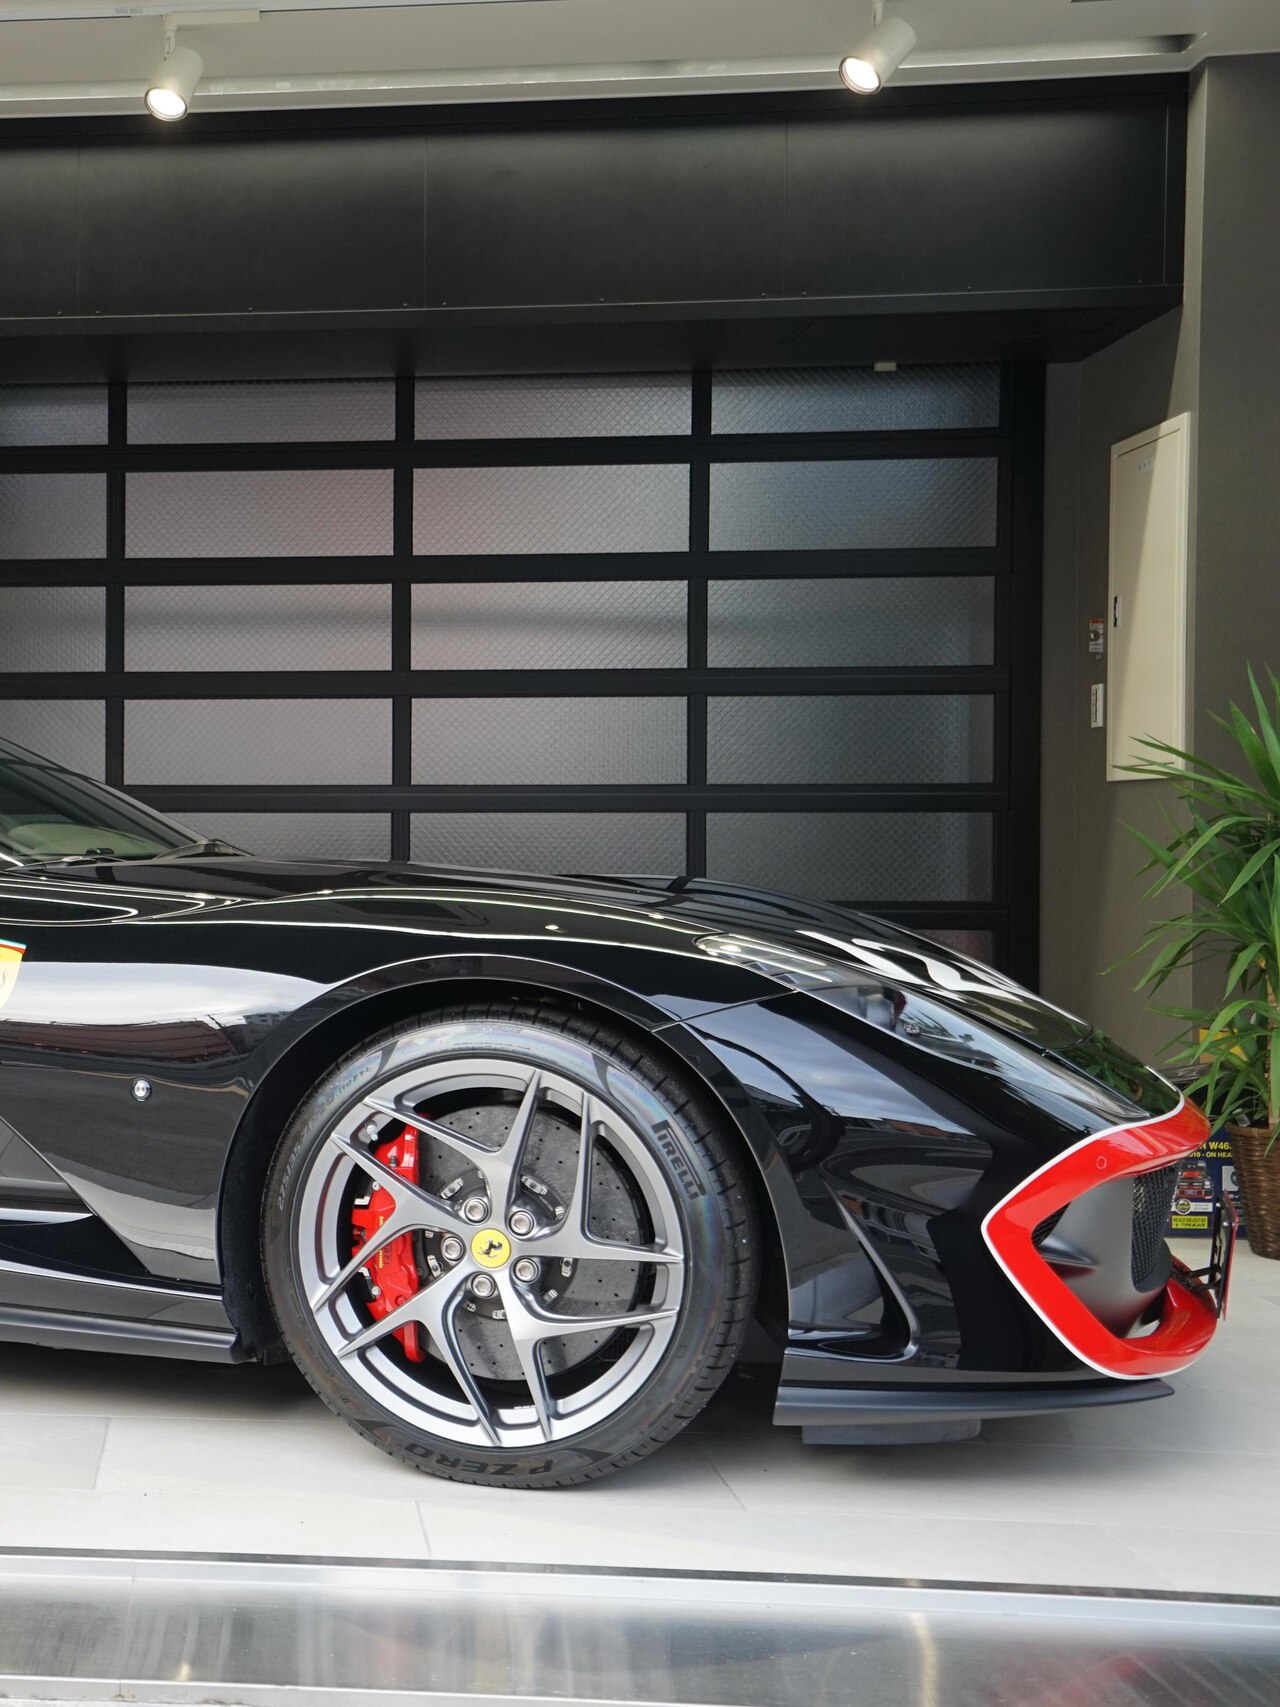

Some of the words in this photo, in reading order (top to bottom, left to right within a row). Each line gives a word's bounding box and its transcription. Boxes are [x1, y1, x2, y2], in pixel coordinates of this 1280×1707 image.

[651, 1120, 707, 1200] PIRELLI
[404, 1443, 518, 1475] ZERO
[528, 1459, 553, 1475] P
